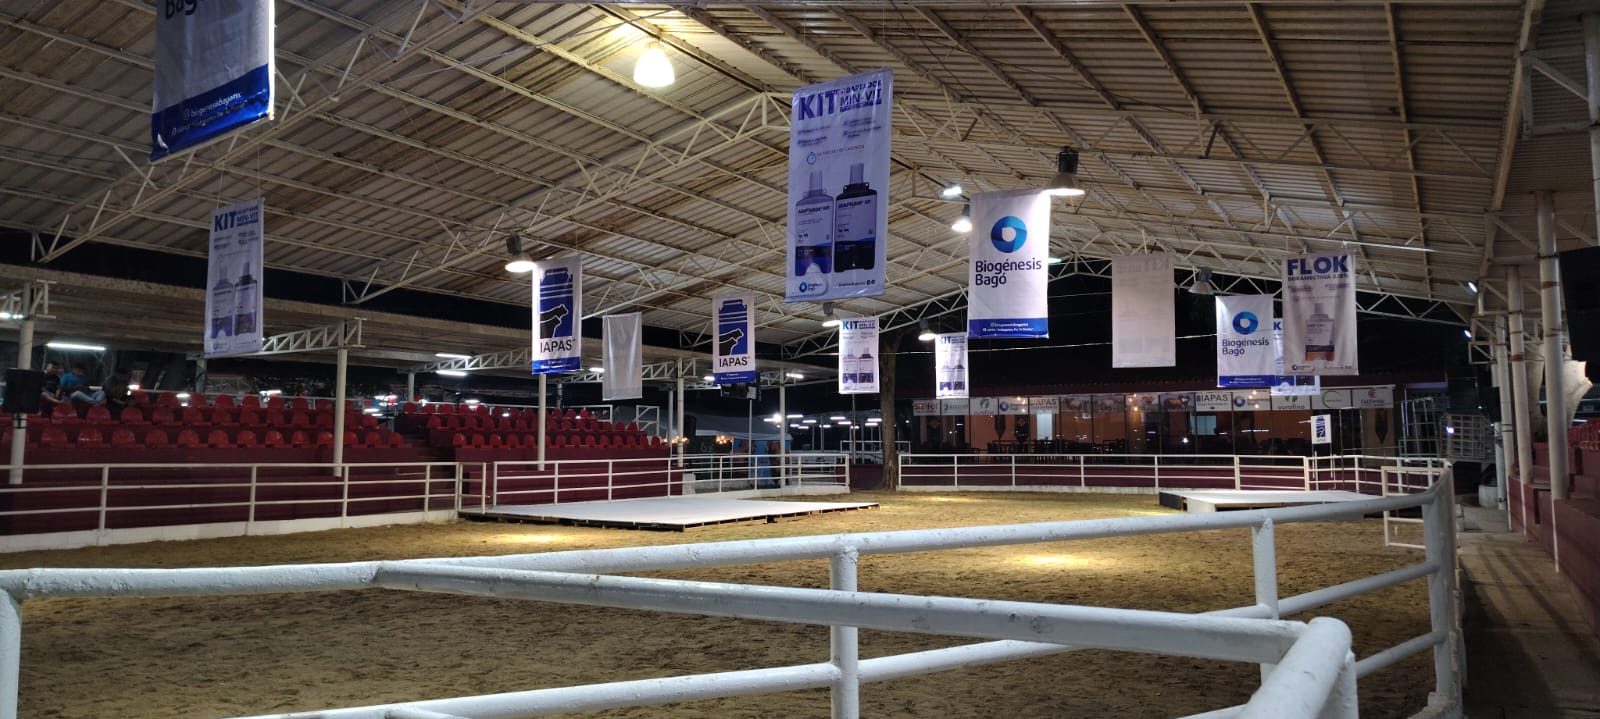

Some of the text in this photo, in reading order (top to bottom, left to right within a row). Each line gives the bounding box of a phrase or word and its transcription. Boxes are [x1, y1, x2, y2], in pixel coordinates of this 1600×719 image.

[798, 91, 836, 120] KIT
[215, 211, 237, 232] KIT
[976, 257, 1042, 275] Biogénesis
[1288, 255, 1349, 276] FLOK
[976, 272, 1007, 288] Bagó
[843, 320, 859, 330] KIT
[541, 339, 573, 353] IAPAS
[1222, 337, 1269, 348] Biogénesis
[1222, 346, 1245, 357] Bagó
[720, 356, 748, 368] IAPAS
[1201, 393, 1229, 402] IAPAS
